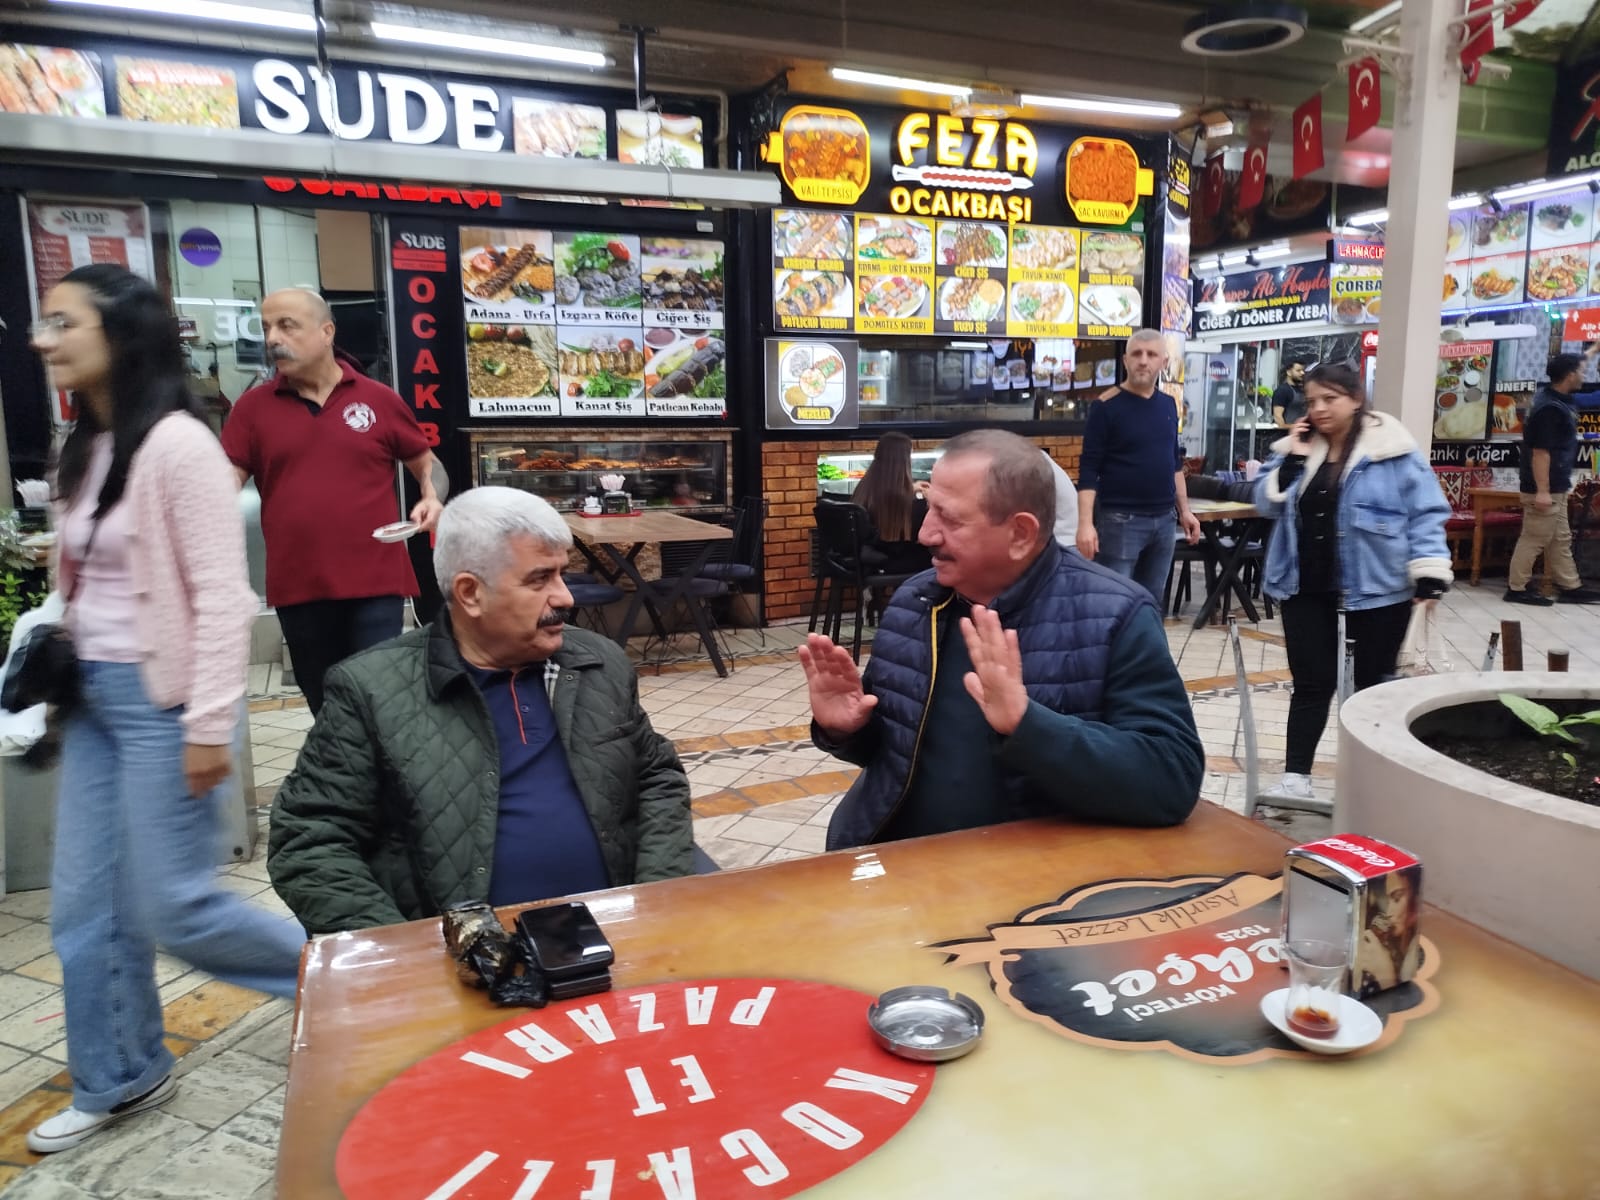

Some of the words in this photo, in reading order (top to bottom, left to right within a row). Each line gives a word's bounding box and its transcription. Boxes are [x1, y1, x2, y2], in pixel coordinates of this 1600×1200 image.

[252, 58, 505, 153] SUDE
[897, 112, 1038, 178] FEZA
[61, 207, 111, 227] SUDE
[889, 185, 1033, 226] OCAKBAŞI
[400, 232, 446, 251] SUDE
[470, 308, 511, 320] Adana
[523, 310, 551, 321] Urfa
[604, 311, 638, 322] Köfte
[656, 311, 690, 325] Ciğer
[693, 312, 712, 326] Şiş
[863, 319, 899, 330] DOMATES
[1241, 307, 1284, 327] DÖNER
[1295, 303, 1329, 321] KEBA
[408, 276, 443, 447] OCAKB
[478, 401, 552, 413] Lahmacun
[574, 401, 612, 412] Kanat
[615, 401, 633, 414] Şiş
[1430, 445, 1459, 461] anki
[1465, 444, 1510, 464] Ciğer
[1157, 888, 1241, 925] Asırlık
[1048, 915, 1152, 947] Lezzet
[1214, 922, 1272, 943] 1925
[1069, 937, 1281, 1017] ehçet
[1121, 982, 1238, 1023] KÖFTECİ
[459, 985, 777, 1079] PAZARI
[624, 1054, 717, 1118] ET
